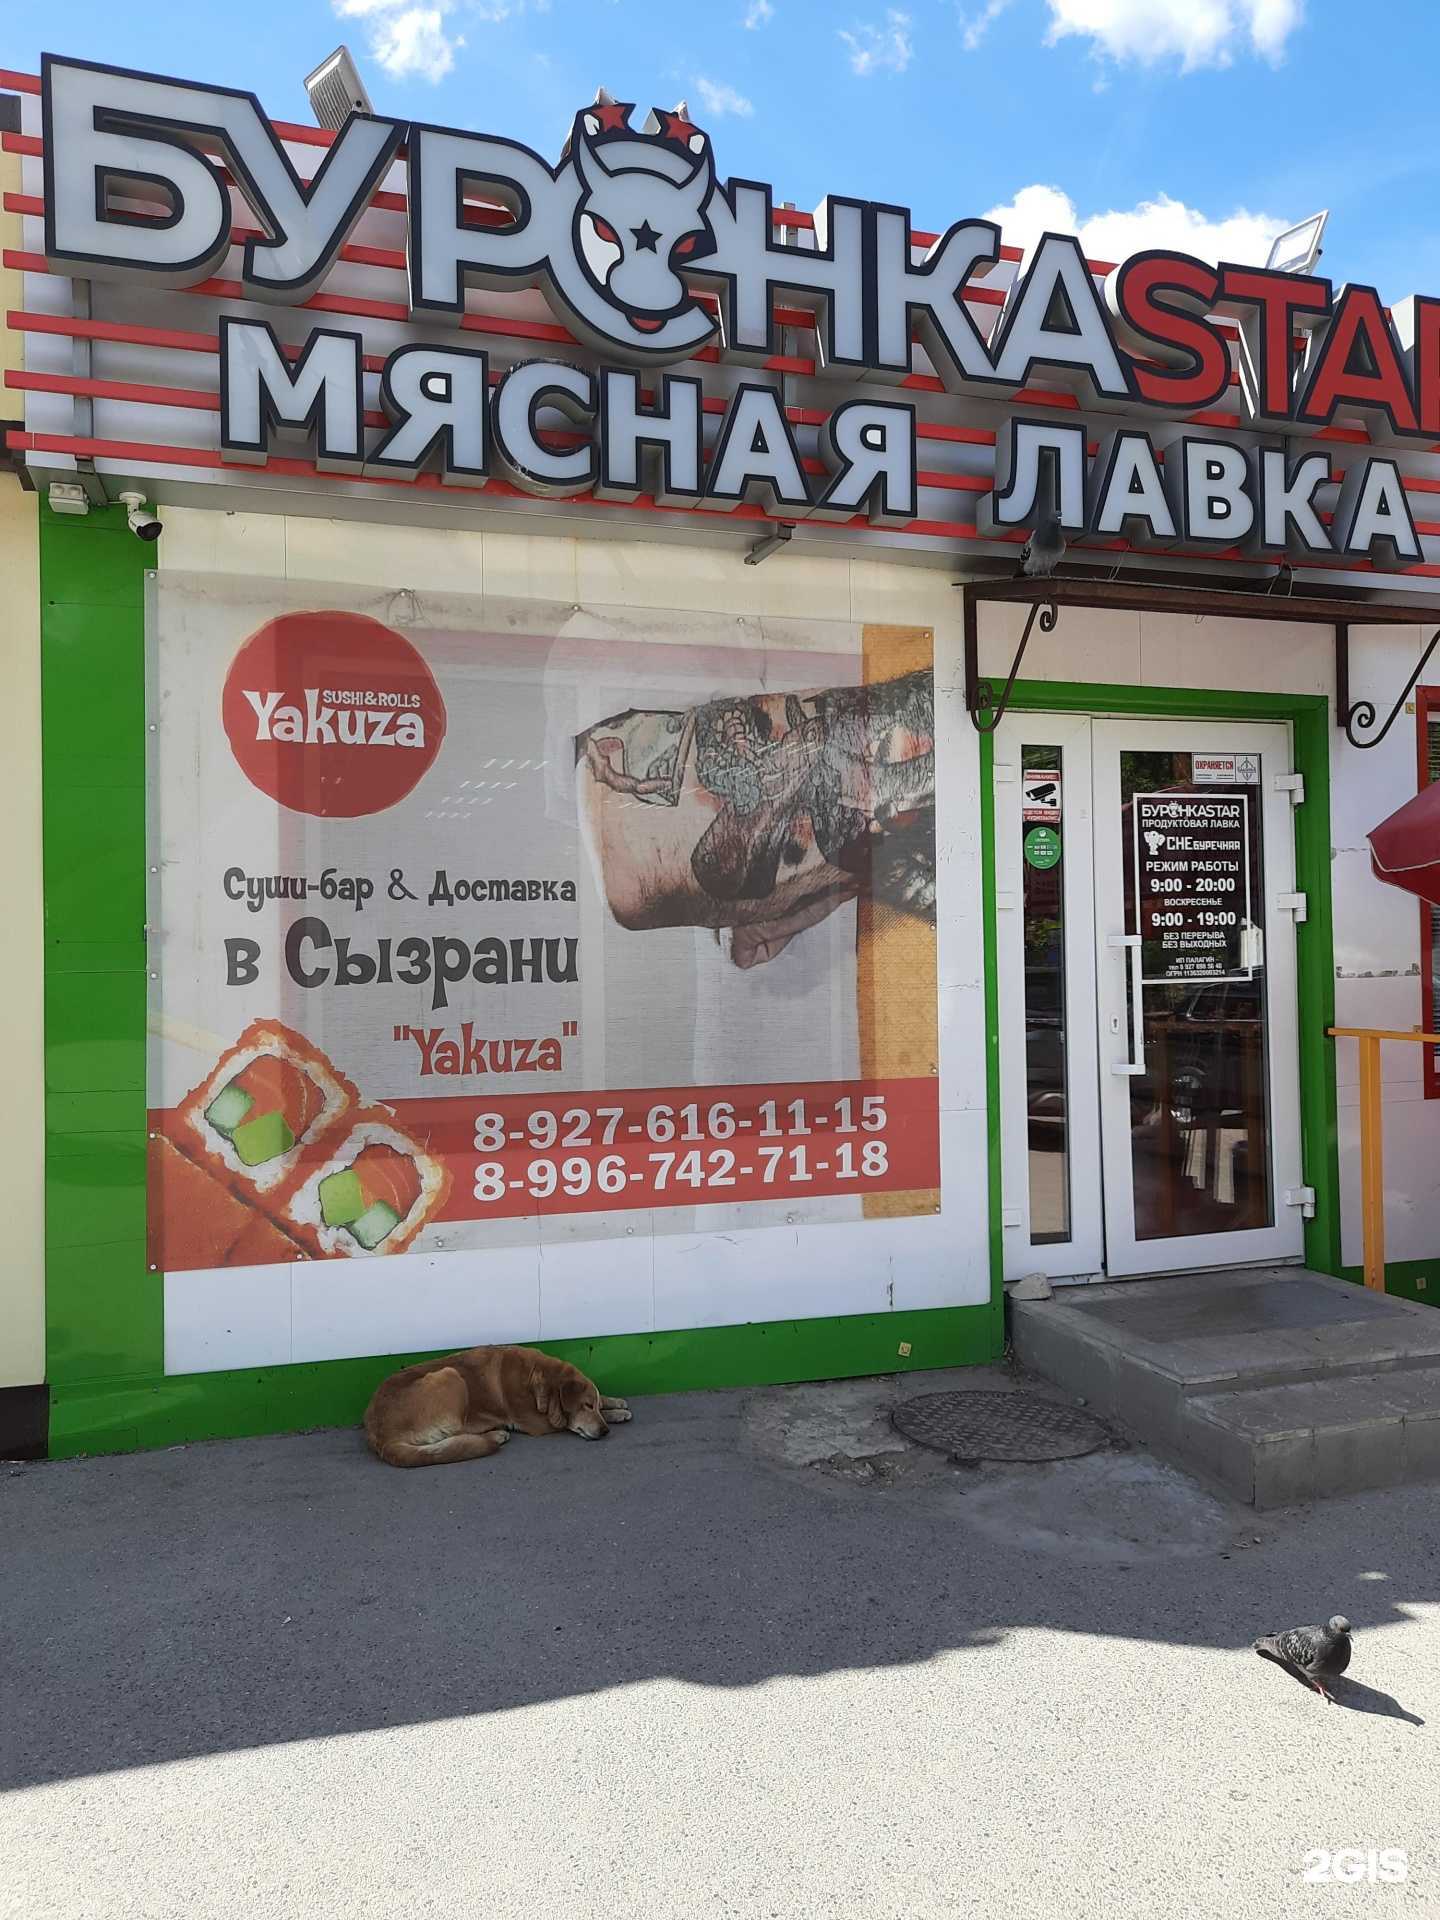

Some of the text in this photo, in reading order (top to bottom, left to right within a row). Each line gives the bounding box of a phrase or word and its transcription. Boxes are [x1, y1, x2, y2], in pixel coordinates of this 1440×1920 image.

[220, 316, 1424, 563] МЯСНАЯ ЛАВКА
[322, 689, 421, 708] SUSHI&ROLLS
[242, 687, 425, 748] Yakuza
[1195, 760, 1234, 770] ОХРАНЯЕТСЯ
[1142, 819, 1240, 829] ПРОДУКТОВАЯ ЛАВКА
[1146, 861, 1239, 872] РЕЖИМ РАБОТЫ
[224, 867, 577, 912] Суши-бар & Доставка
[1150, 878, 1183, 892] 9:00
[1195, 877, 1235, 892] 20:00
[1164, 898, 1223, 906] ВОСКРЕСЕНЬЕ
[1151, 912, 1184, 926] 9:00
[1197, 911, 1236, 925] 19:00
[1162, 939, 1227, 949] БЕЗ ВЫХОДНЫХ
[1163, 931, 1225, 940] БЕЗ ПЕРЕРЫВА
[223, 916, 579, 1011] в Сызрани
[393, 1020, 578, 1076] "Yakuza"
[473, 1096, 888, 1153] 8-927-616-11-15
[472, 1140, 890, 1202] 8-996-742-71-18
